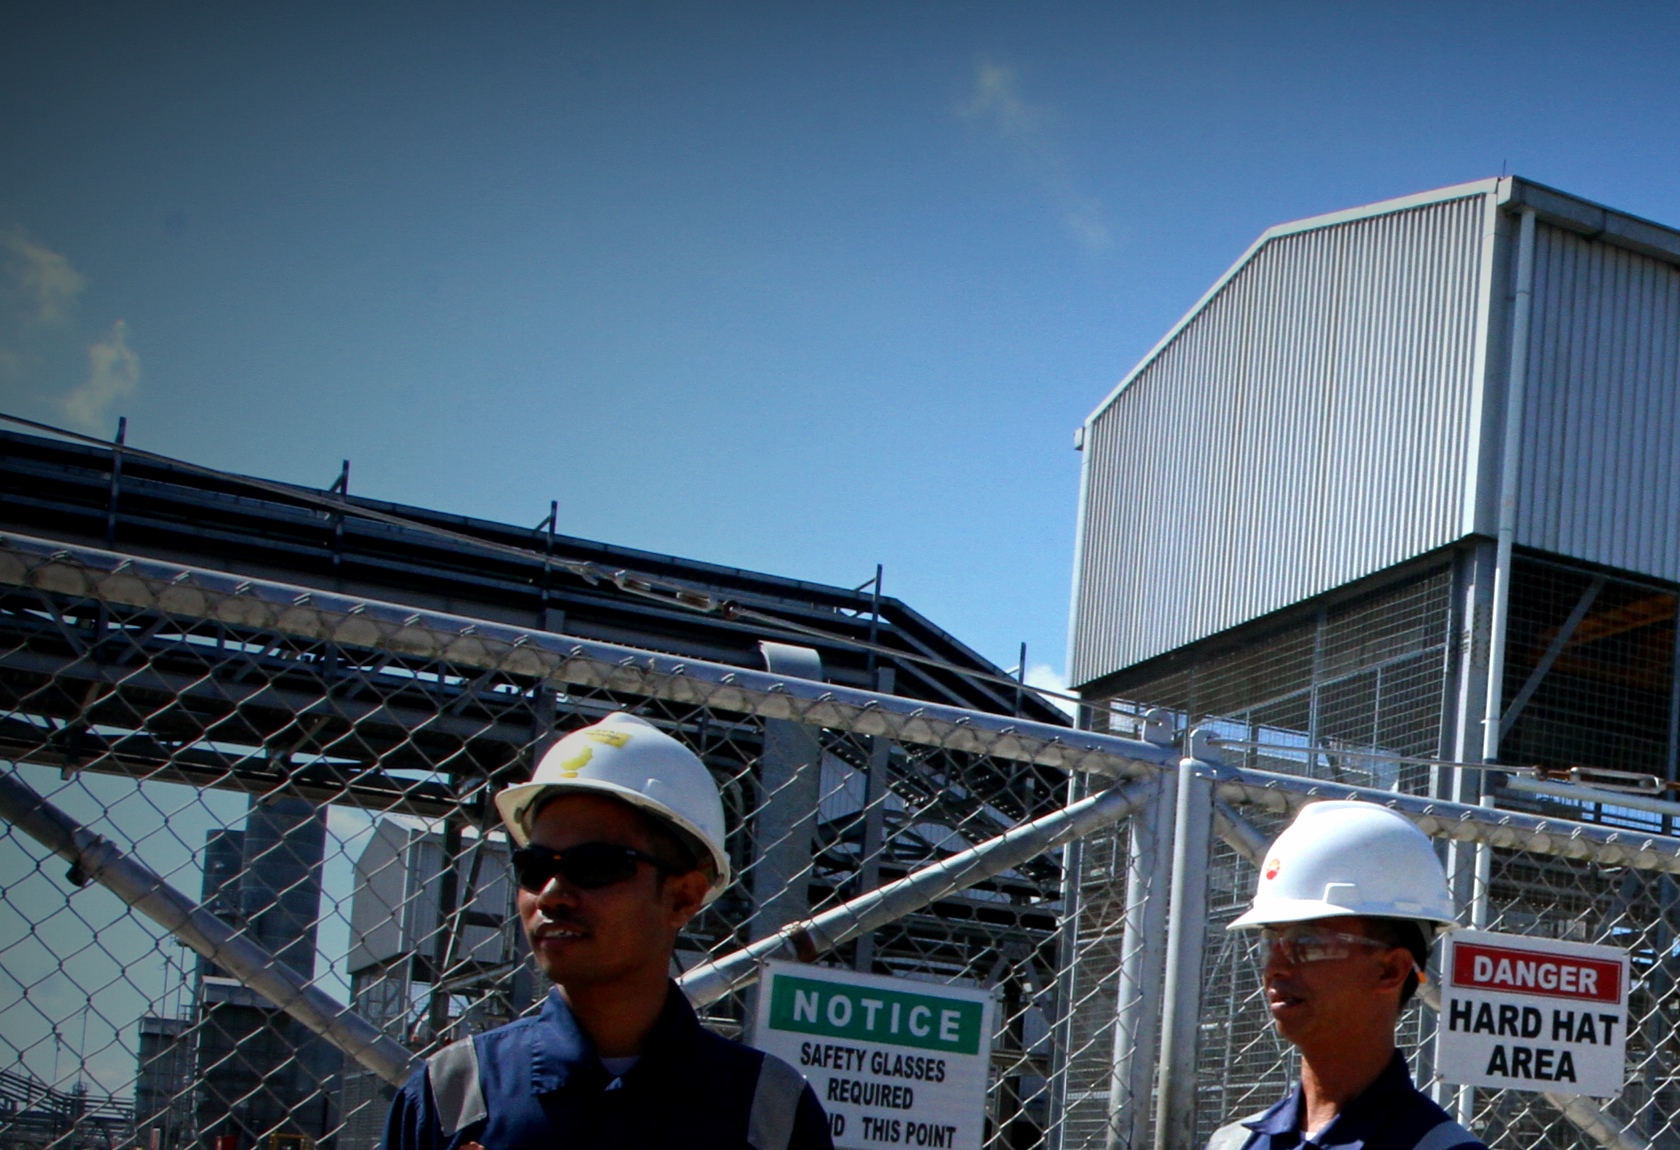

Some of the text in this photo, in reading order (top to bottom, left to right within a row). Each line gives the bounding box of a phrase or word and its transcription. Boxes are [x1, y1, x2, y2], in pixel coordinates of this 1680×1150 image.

[1473, 955, 1598, 994] DANGER
[793, 989, 961, 1042] NOTICE
[1449, 999, 1619, 1046] HARD HAT
[800, 1041, 946, 1082] SAFETY GLASSES
[1486, 1045, 1577, 1083] AREA
[827, 1077, 914, 1110] REQUIRED
[862, 1116, 901, 1143] THIS
[905, 1121, 957, 1149] POINT
